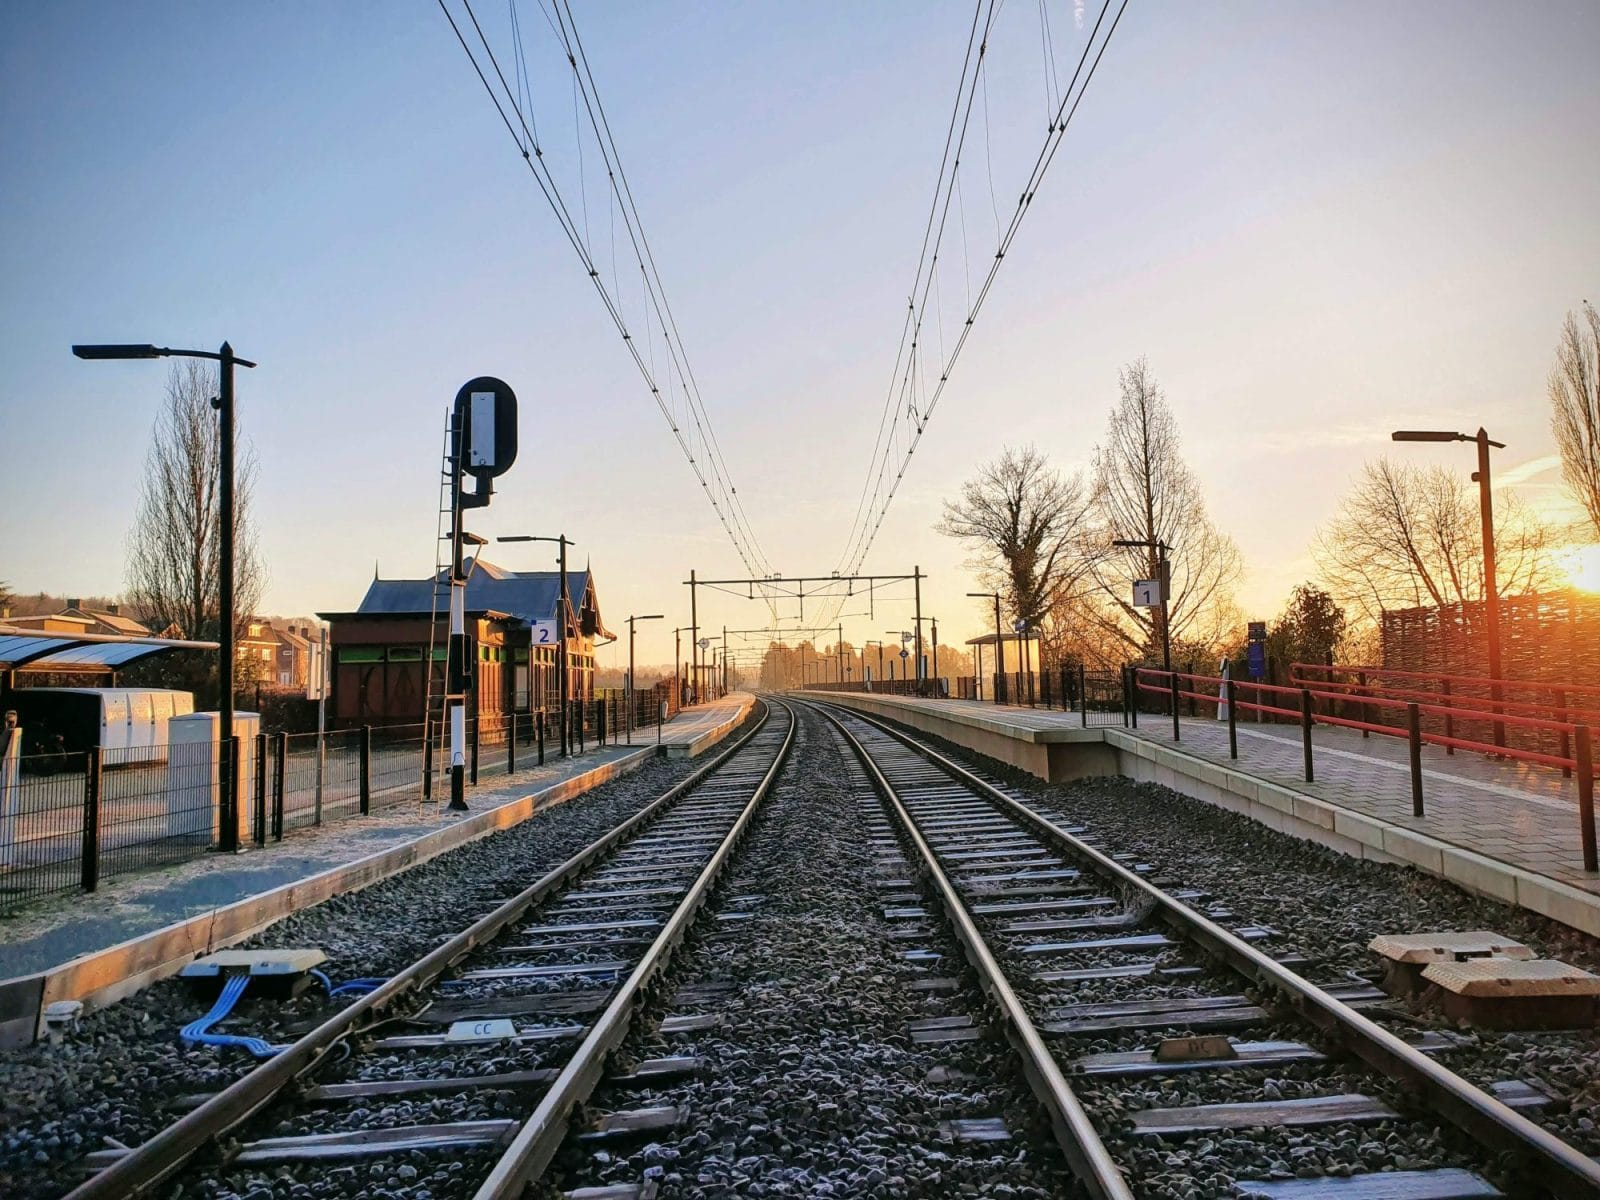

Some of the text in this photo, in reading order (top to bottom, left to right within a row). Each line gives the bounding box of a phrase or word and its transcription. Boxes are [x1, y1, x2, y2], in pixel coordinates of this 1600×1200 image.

[1143, 590, 1150, 604] 1
[539, 628, 550, 643] 2
[474, 1023, 492, 1036] CC
